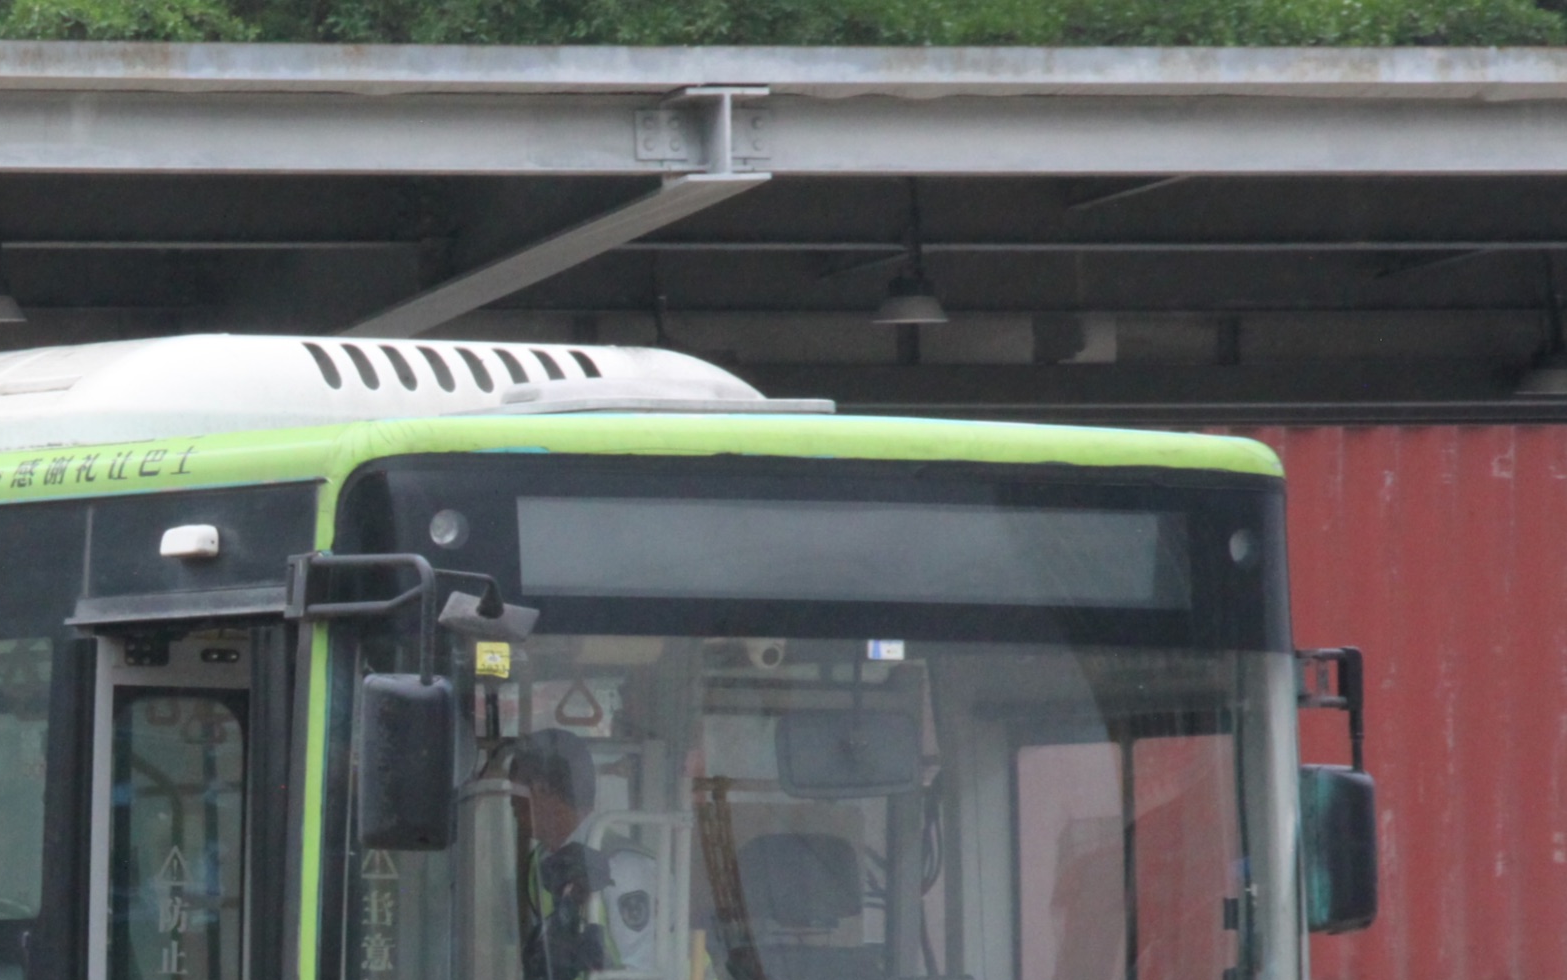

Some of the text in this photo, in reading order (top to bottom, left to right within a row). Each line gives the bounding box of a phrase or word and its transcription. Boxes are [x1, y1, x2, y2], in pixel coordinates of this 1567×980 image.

[10, 445, 201, 490] 感谢礼让巴士
